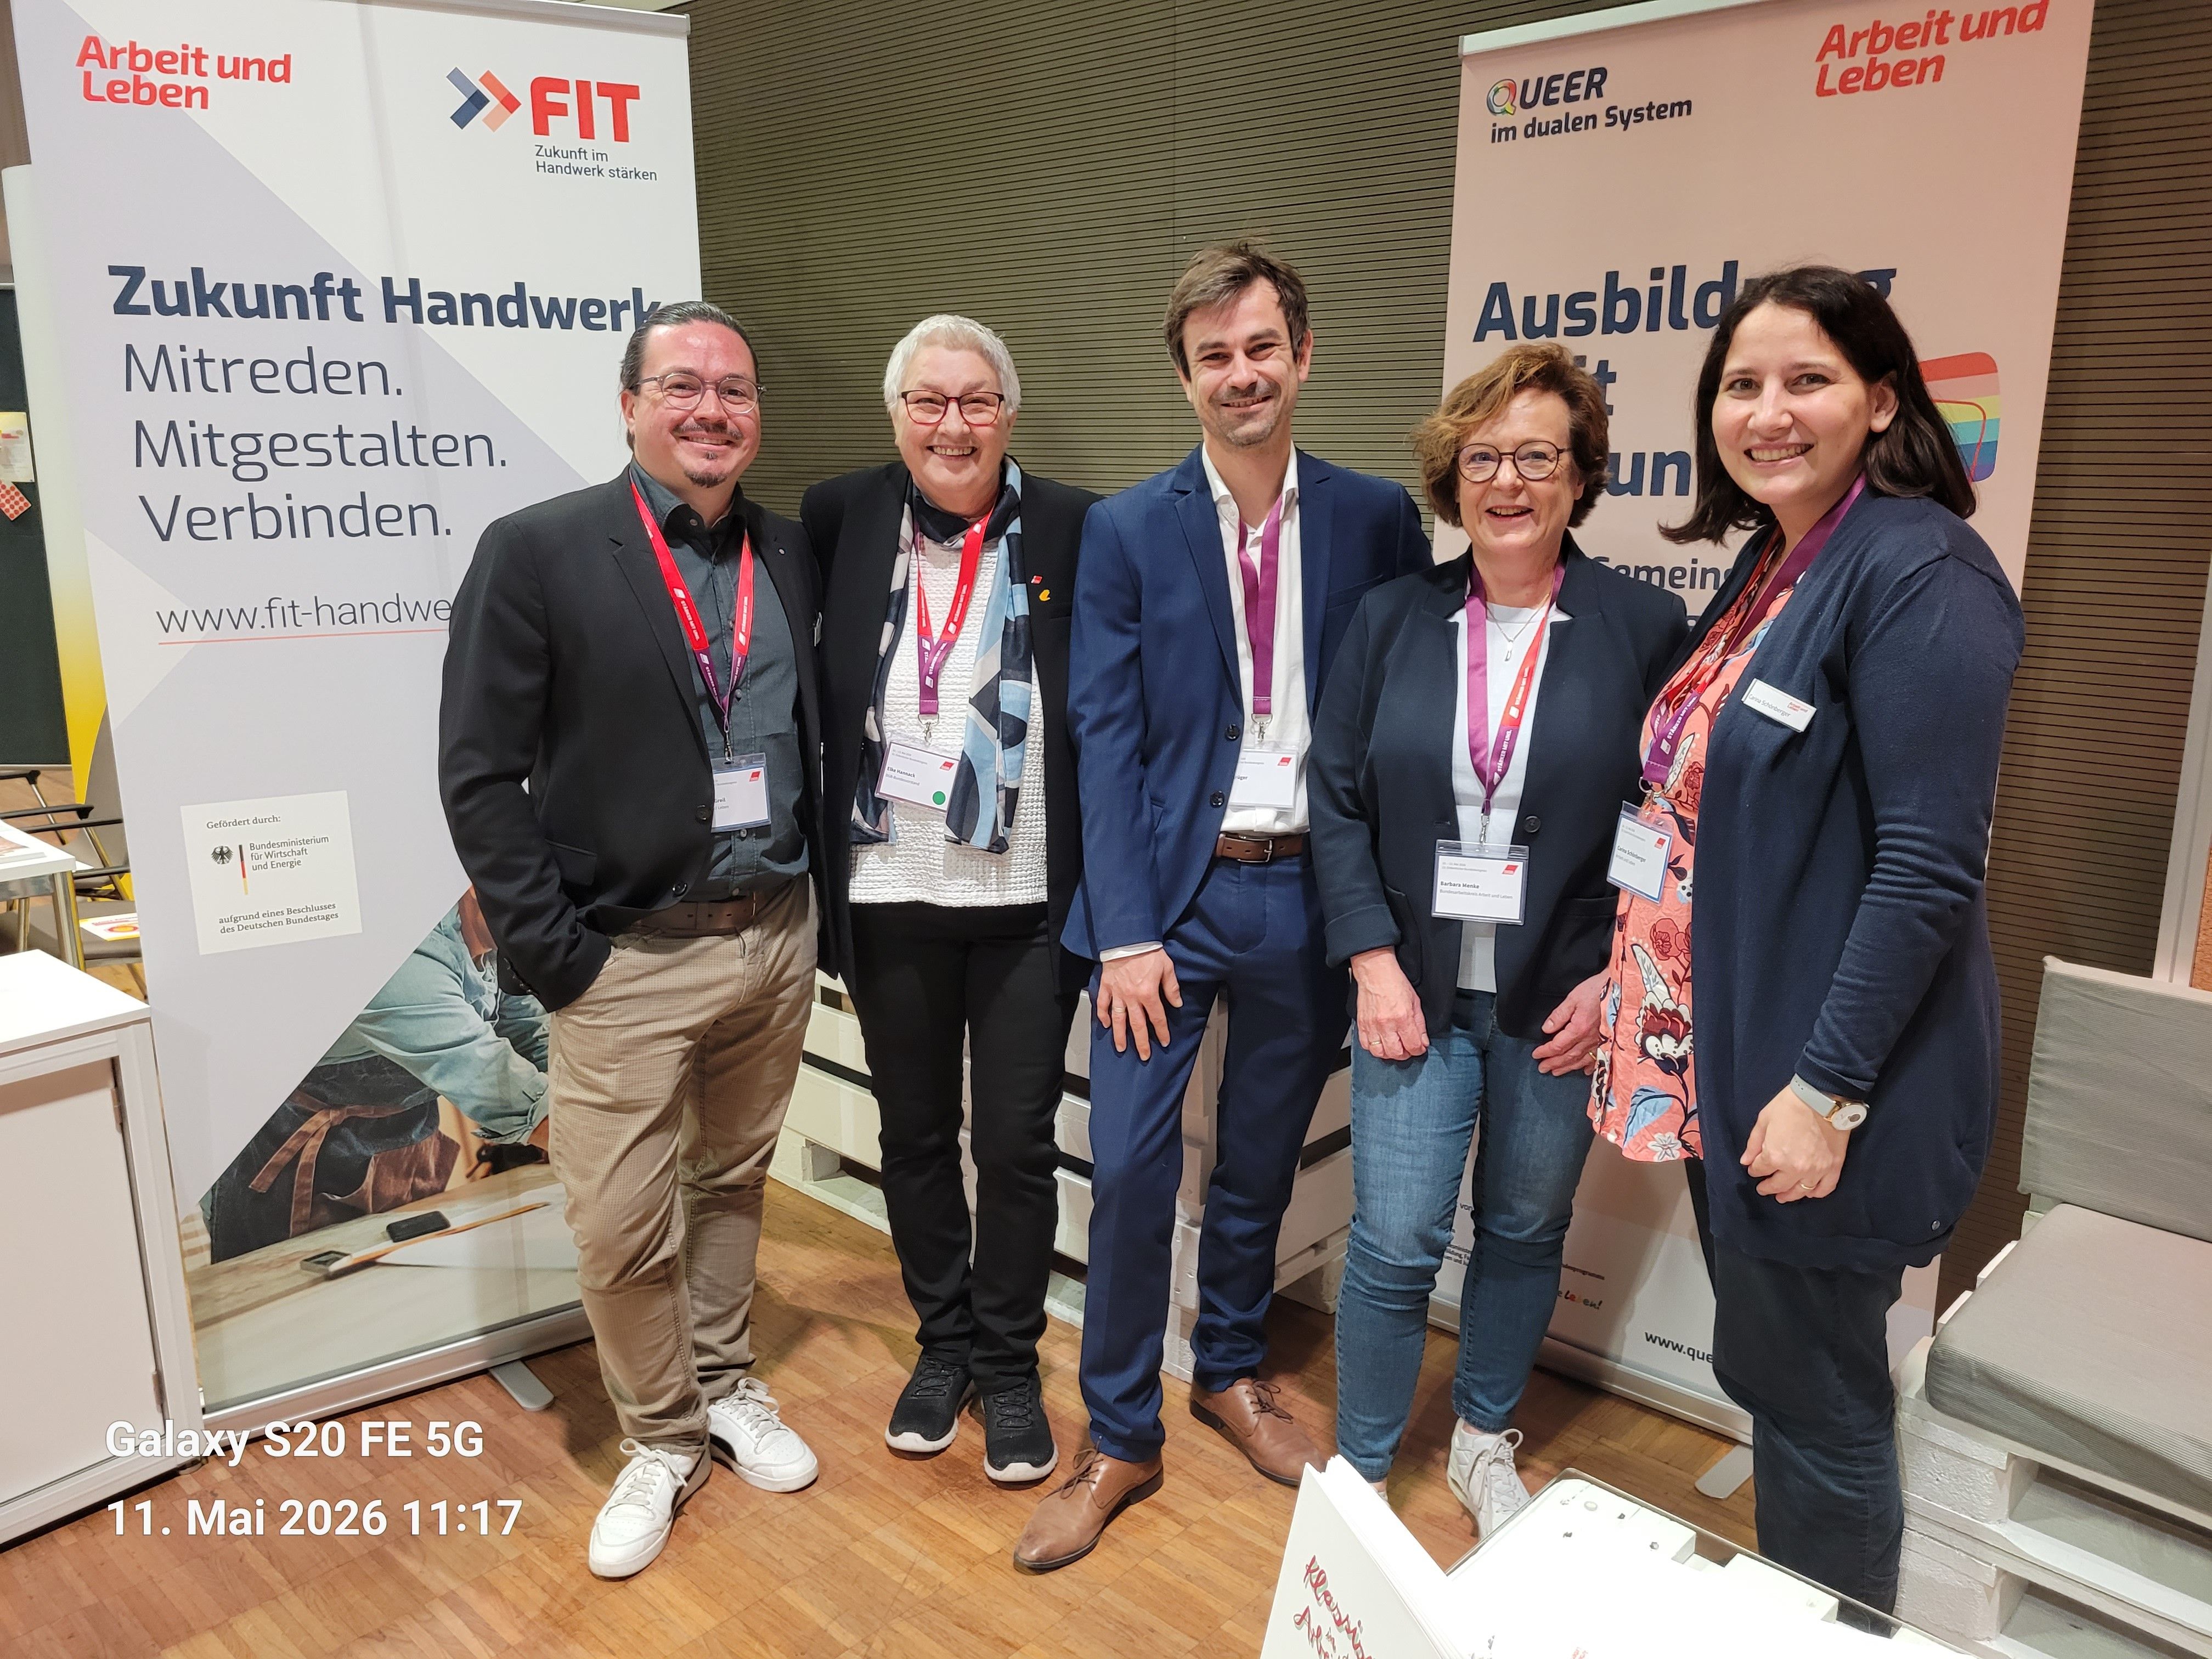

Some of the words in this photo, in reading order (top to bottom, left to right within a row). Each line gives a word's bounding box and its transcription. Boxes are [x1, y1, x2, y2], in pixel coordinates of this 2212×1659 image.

[1815, 9, 1955, 62] Arbeit
[1959, 0, 2049, 42] und
[76, 35, 209, 77] Arbeit
[216, 52, 291, 83] und
[1815, 53, 1945, 97] Leben
[82, 70, 208, 109] Leben
[530, 76, 640, 142] FIT
[1486, 67, 1607, 116] QUEER
[1491, 123, 1516, 143] im
[1523, 111, 1597, 140] dualen
[1605, 97, 1692, 132] System
[535, 145, 588, 162] Zukunft
[591, 149, 608, 162] im
[536, 161, 605, 178] Handwerk
[608, 166, 658, 182] stärken
[108, 265, 363, 323] Zukunft
[382, 276, 661, 331] Handwerk
[1473, 260, 1897, 343] Ausbild
[126, 343, 402, 396] Mitreden.
[135, 420, 506, 482] Mitgestalten.
[139, 491, 451, 541] Verbinden.
[156, 592, 452, 634] www.fit-handwe
[206, 818, 250, 829] Gefördert
[252, 815, 281, 824] durch:
[250, 836, 329, 851] Bundesministerium
[251, 853, 263, 861] für
[264, 847, 308, 860] Wirtschaft
[252, 862, 268, 871] und
[270, 859, 302, 870] Energie
[219, 912, 260, 924] aufgrund
[262, 909, 285, 918] eines
[286, 902, 336, 915] Beschlusses
[220, 925, 235, 934] des
[237, 919, 284, 932] Deutschen
[286, 912, 339, 926] Bundestages
